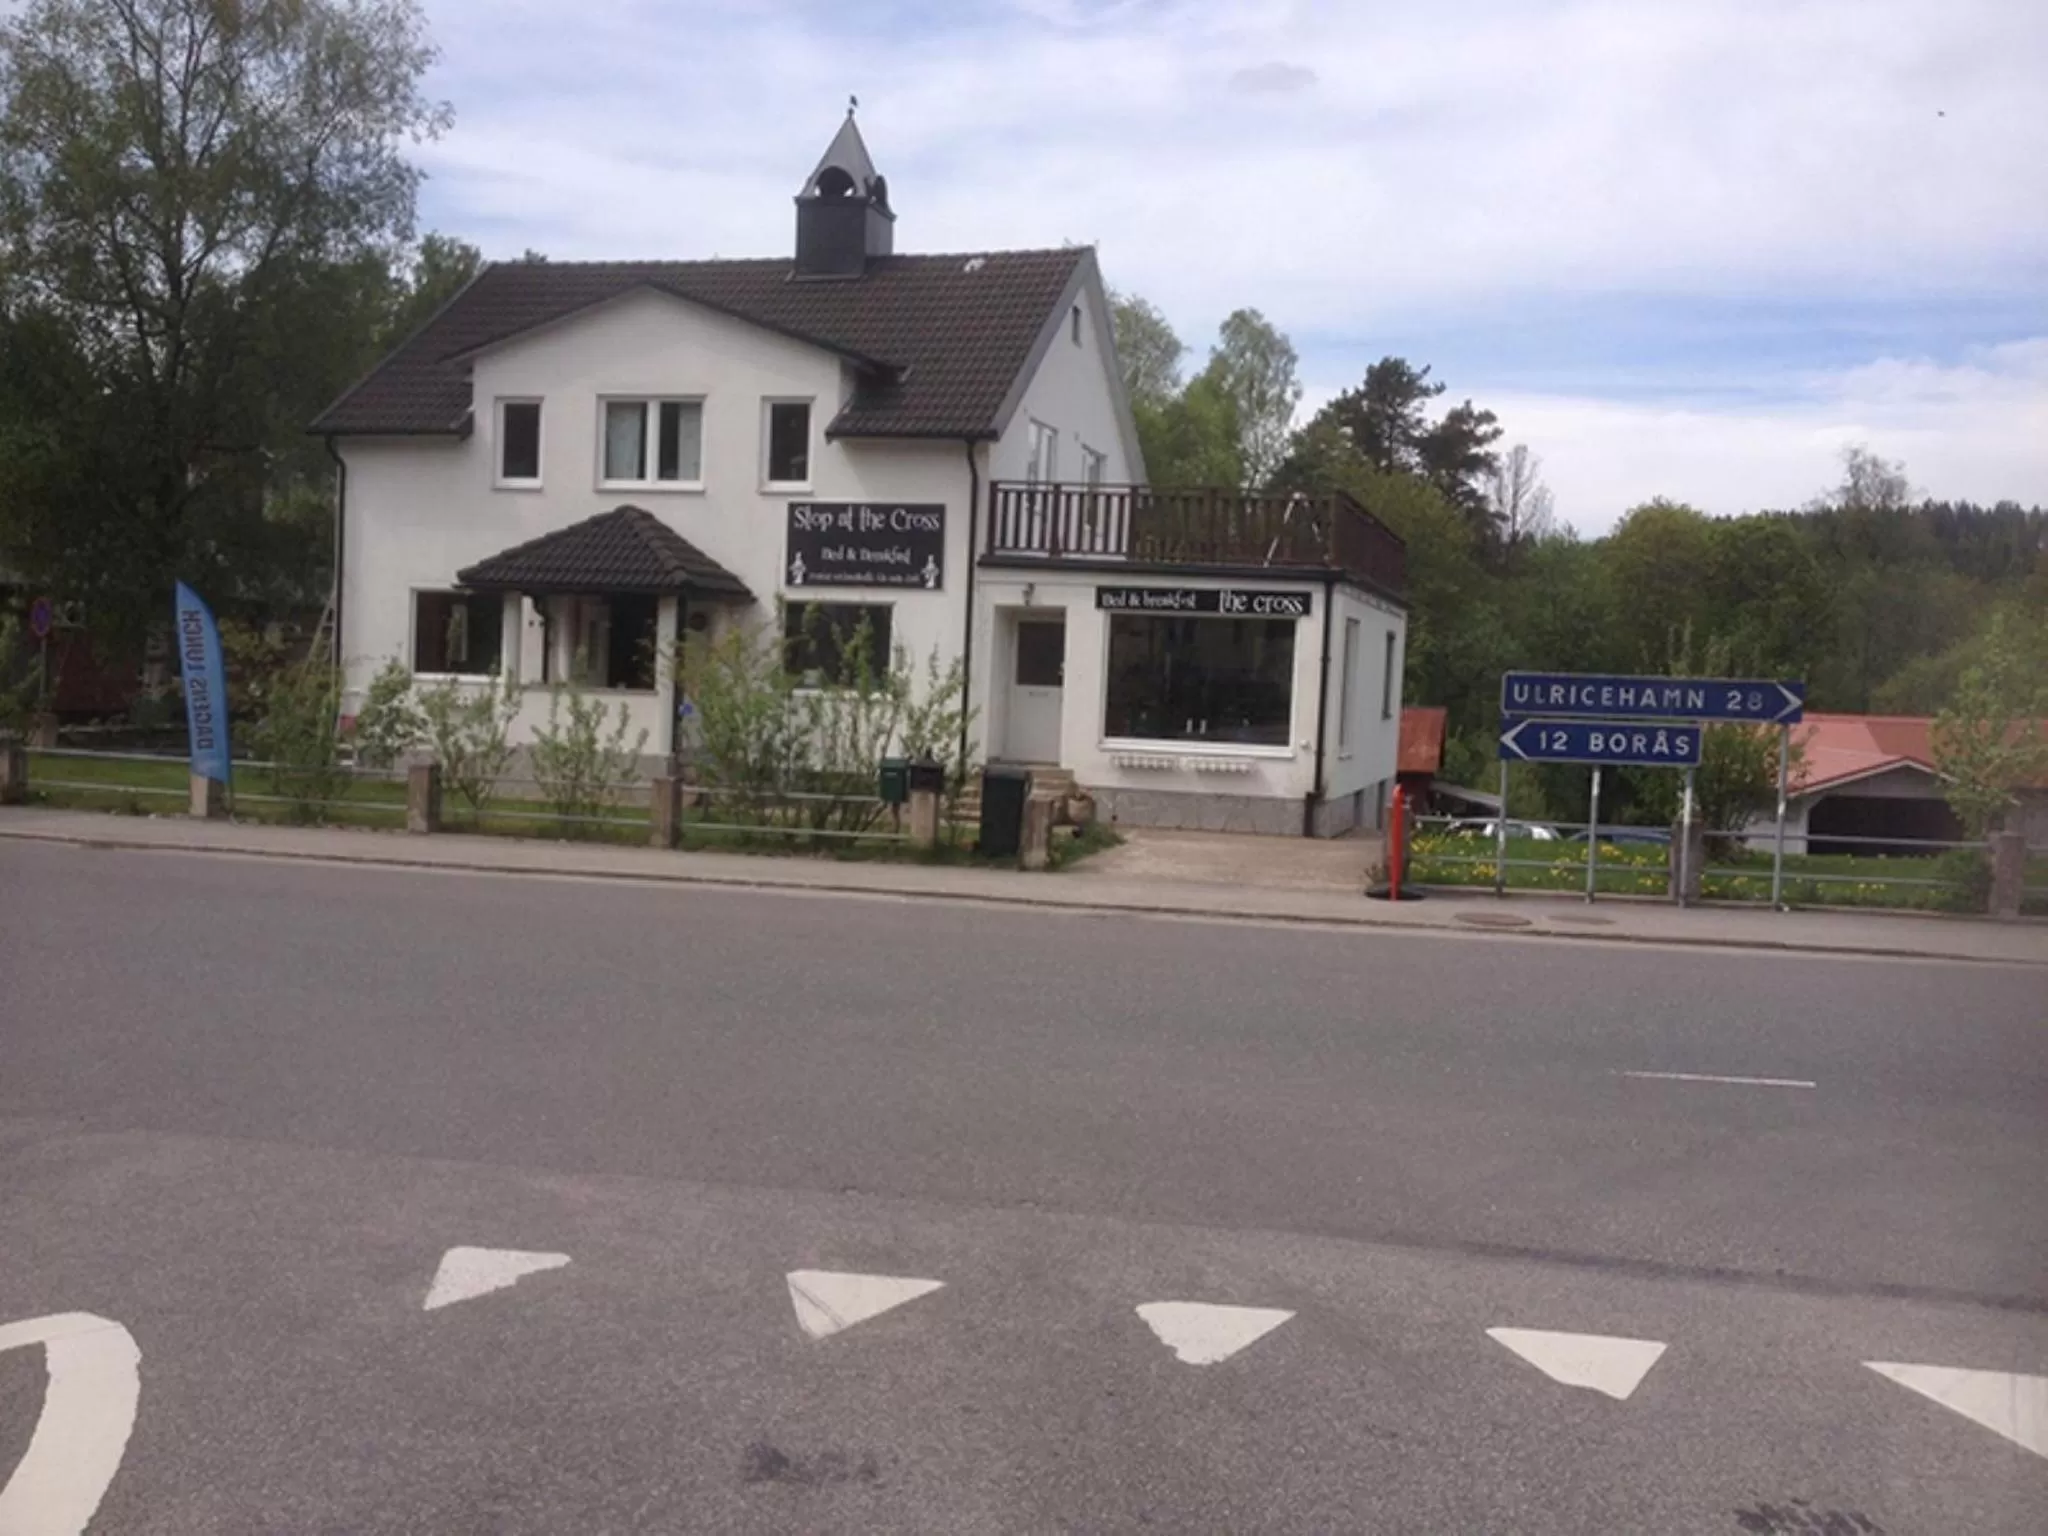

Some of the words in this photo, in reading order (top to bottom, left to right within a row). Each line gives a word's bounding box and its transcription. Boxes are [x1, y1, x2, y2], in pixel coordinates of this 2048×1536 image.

[794, 504, 834, 532] Stop
[838, 504, 854, 532] at
[860, 505, 886, 532] the
[890, 508, 940, 532] Cross
[1253, 593, 1304, 613] cross
[1513, 682, 1706, 710] ULRICEHAMN
[1725, 690, 1764, 711] 28
[1539, 730, 1569, 752] 12
[1588, 729, 1692, 756] BORÅS
